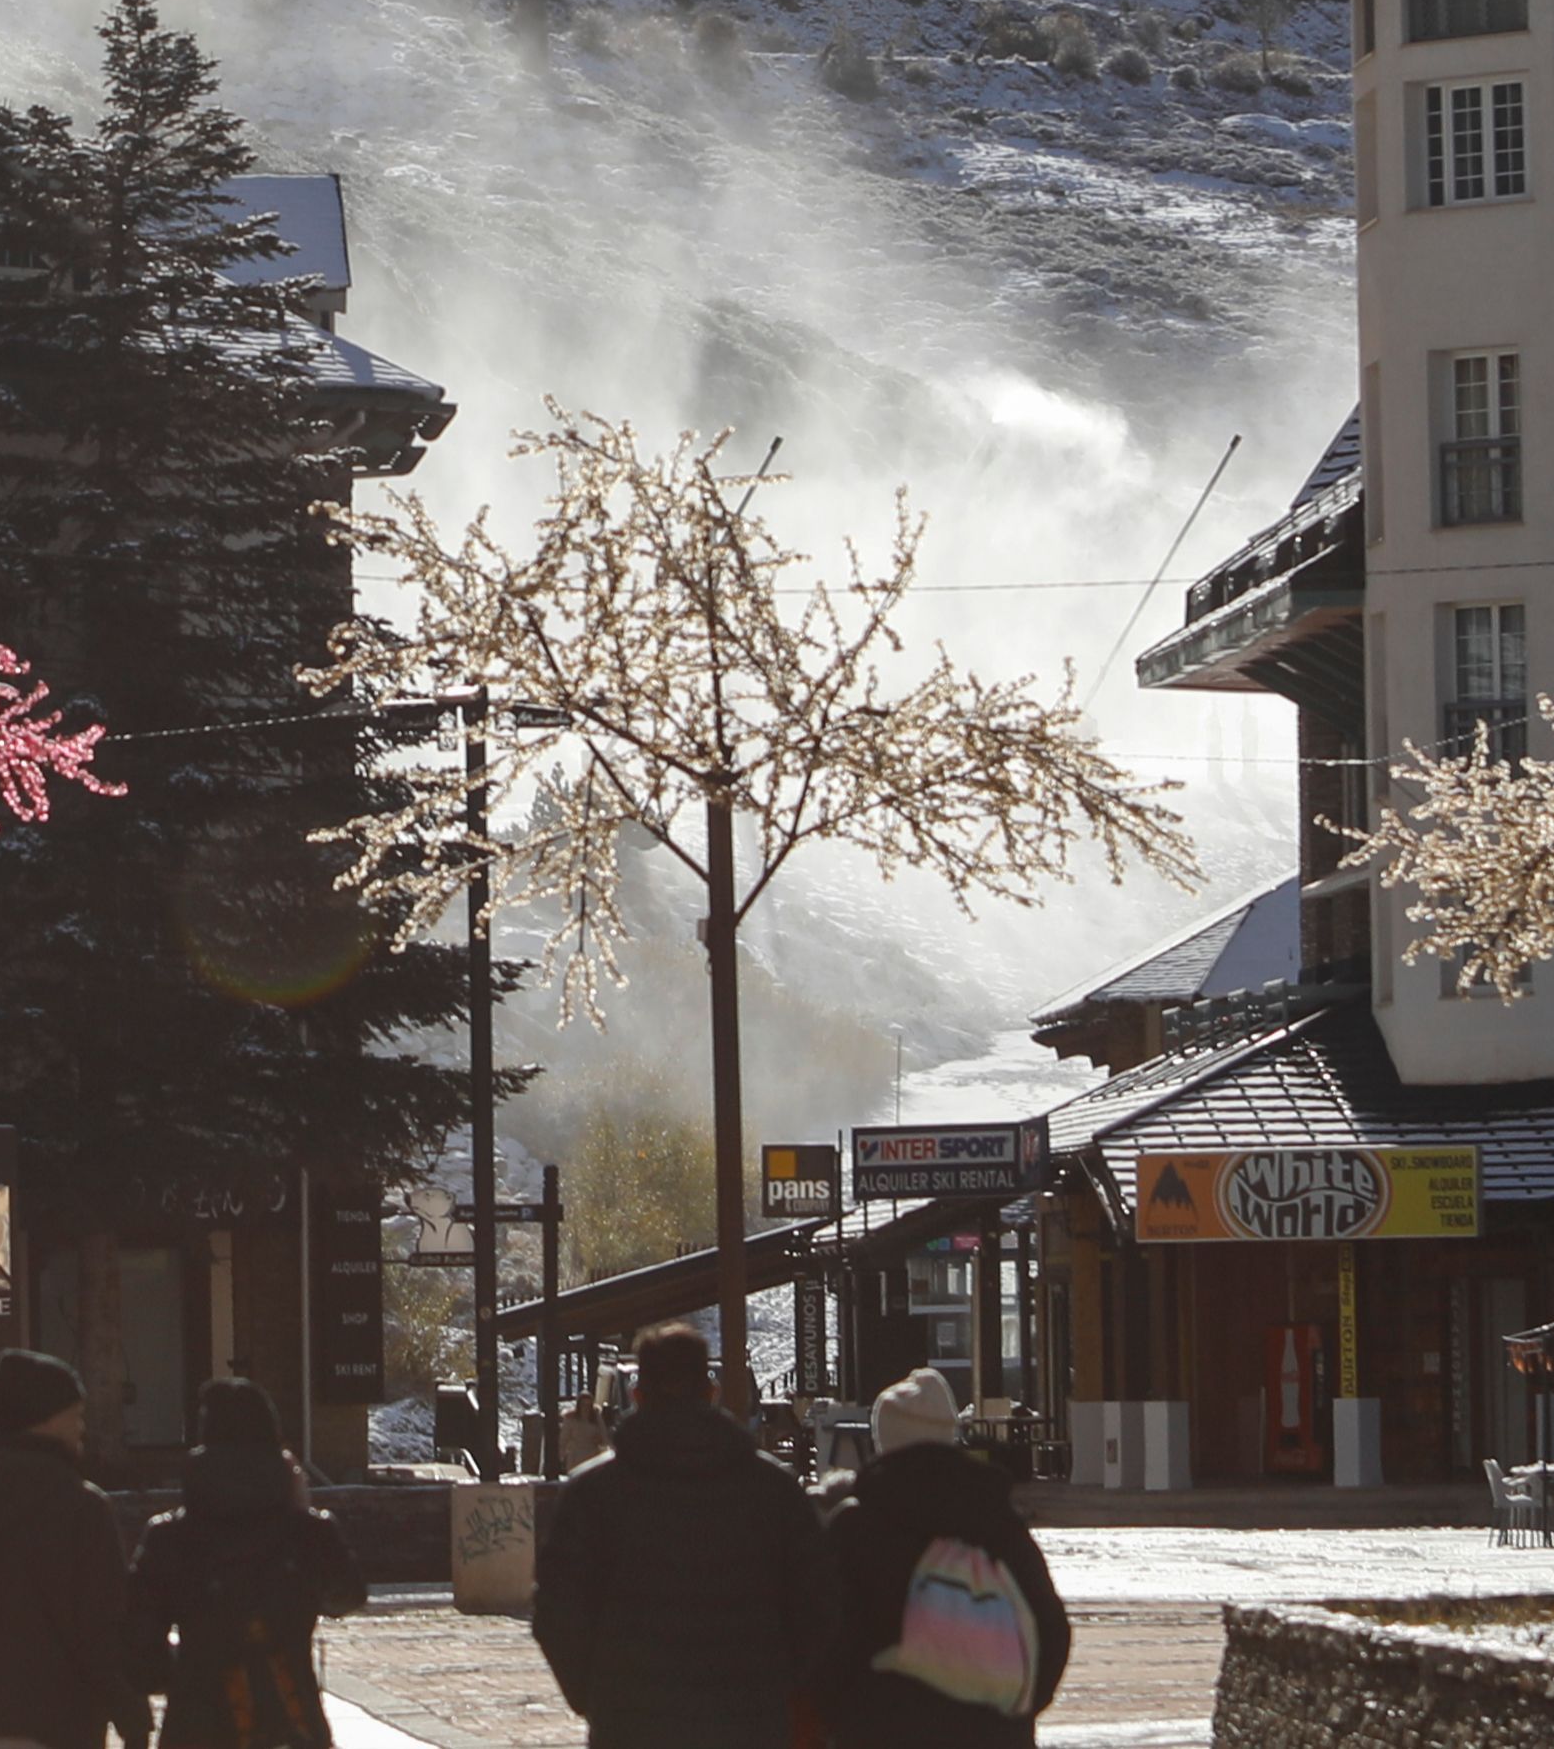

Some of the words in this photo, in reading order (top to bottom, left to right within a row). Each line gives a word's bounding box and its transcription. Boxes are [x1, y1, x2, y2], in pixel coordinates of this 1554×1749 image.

[857, 1170, 929, 1193] ALQUILER
[932, 1170, 957, 1191] SKI
[960, 1168, 1015, 1189] RENTAL
[1243, 1151, 1378, 1201] White
[768, 1179, 831, 1206] pans
[336, 1210, 371, 1223] TIENDA
[1237, 1196, 1374, 1238] World
[331, 1261, 378, 1276] ALQUILER
[341, 1312, 369, 1326] SHOP
[803, 1294, 818, 1391] DESAYUNOS
